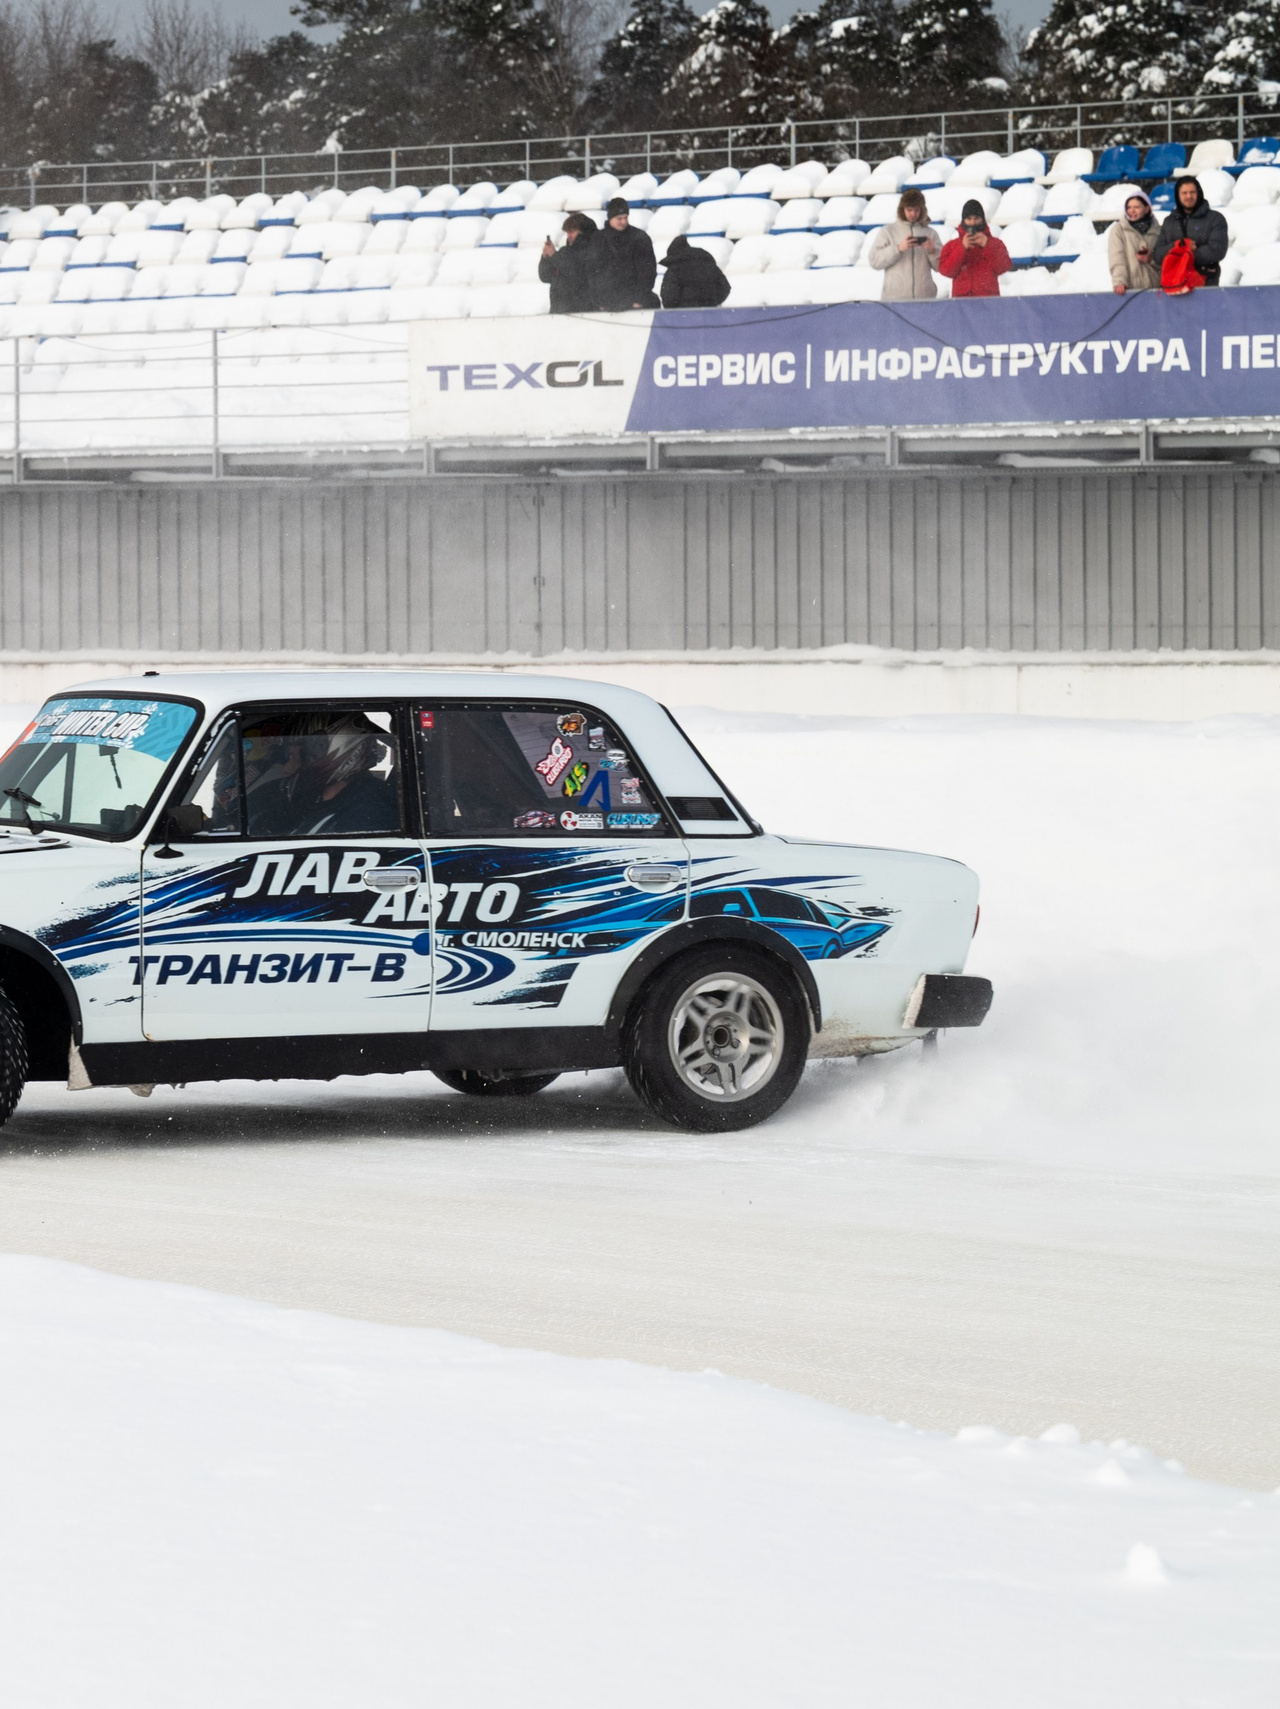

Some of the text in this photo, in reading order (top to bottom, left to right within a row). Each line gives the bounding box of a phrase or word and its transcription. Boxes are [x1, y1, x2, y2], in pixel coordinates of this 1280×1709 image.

[426, 360, 624, 391] TEXOL
[653, 334, 1280, 388] СЕРВИС ИНФРАСТРУКТУРА ПЕ
[101, 711, 151, 740] CUP
[233, 851, 381, 898] ЛАВ
[362, 882, 521, 924] АВТО
[461, 931, 589, 948] СМОЛЕНСК
